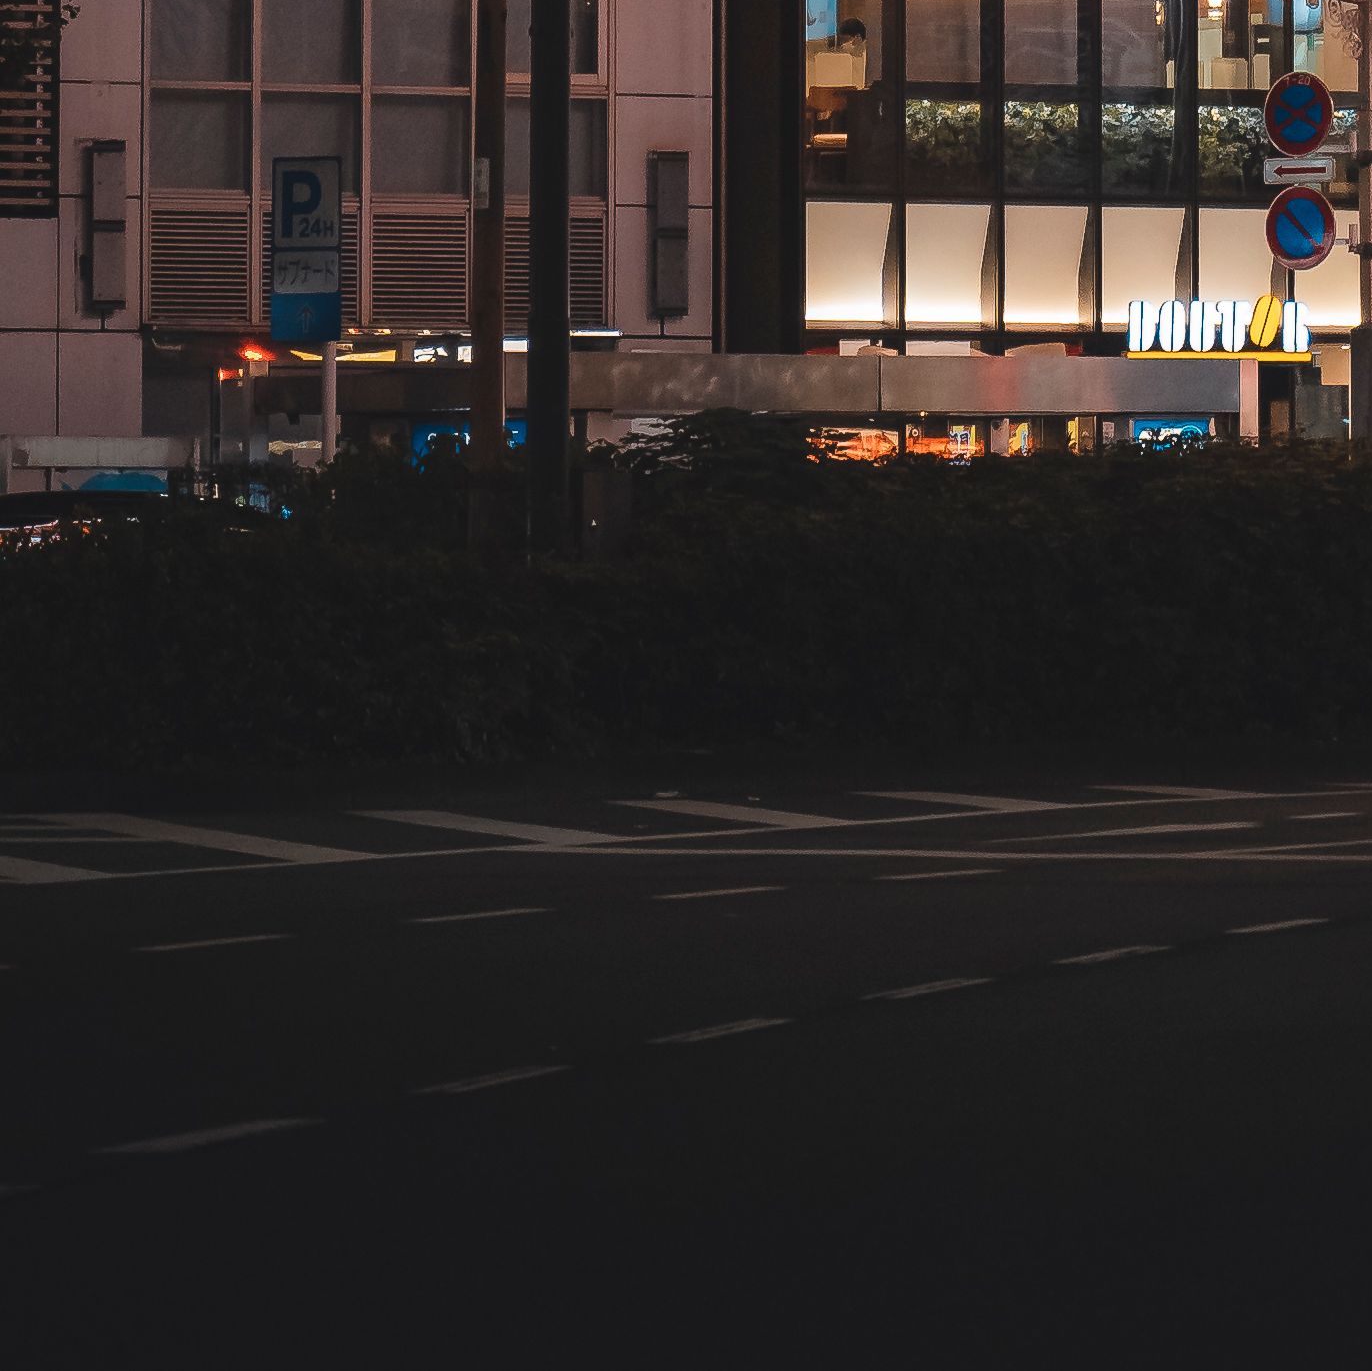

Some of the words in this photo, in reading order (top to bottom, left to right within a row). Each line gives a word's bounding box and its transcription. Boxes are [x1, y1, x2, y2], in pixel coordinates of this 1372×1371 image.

[281, 170, 322, 239] P
[300, 218, 334, 239] 24H
[1128, 294, 1312, 353] DOUTOR
